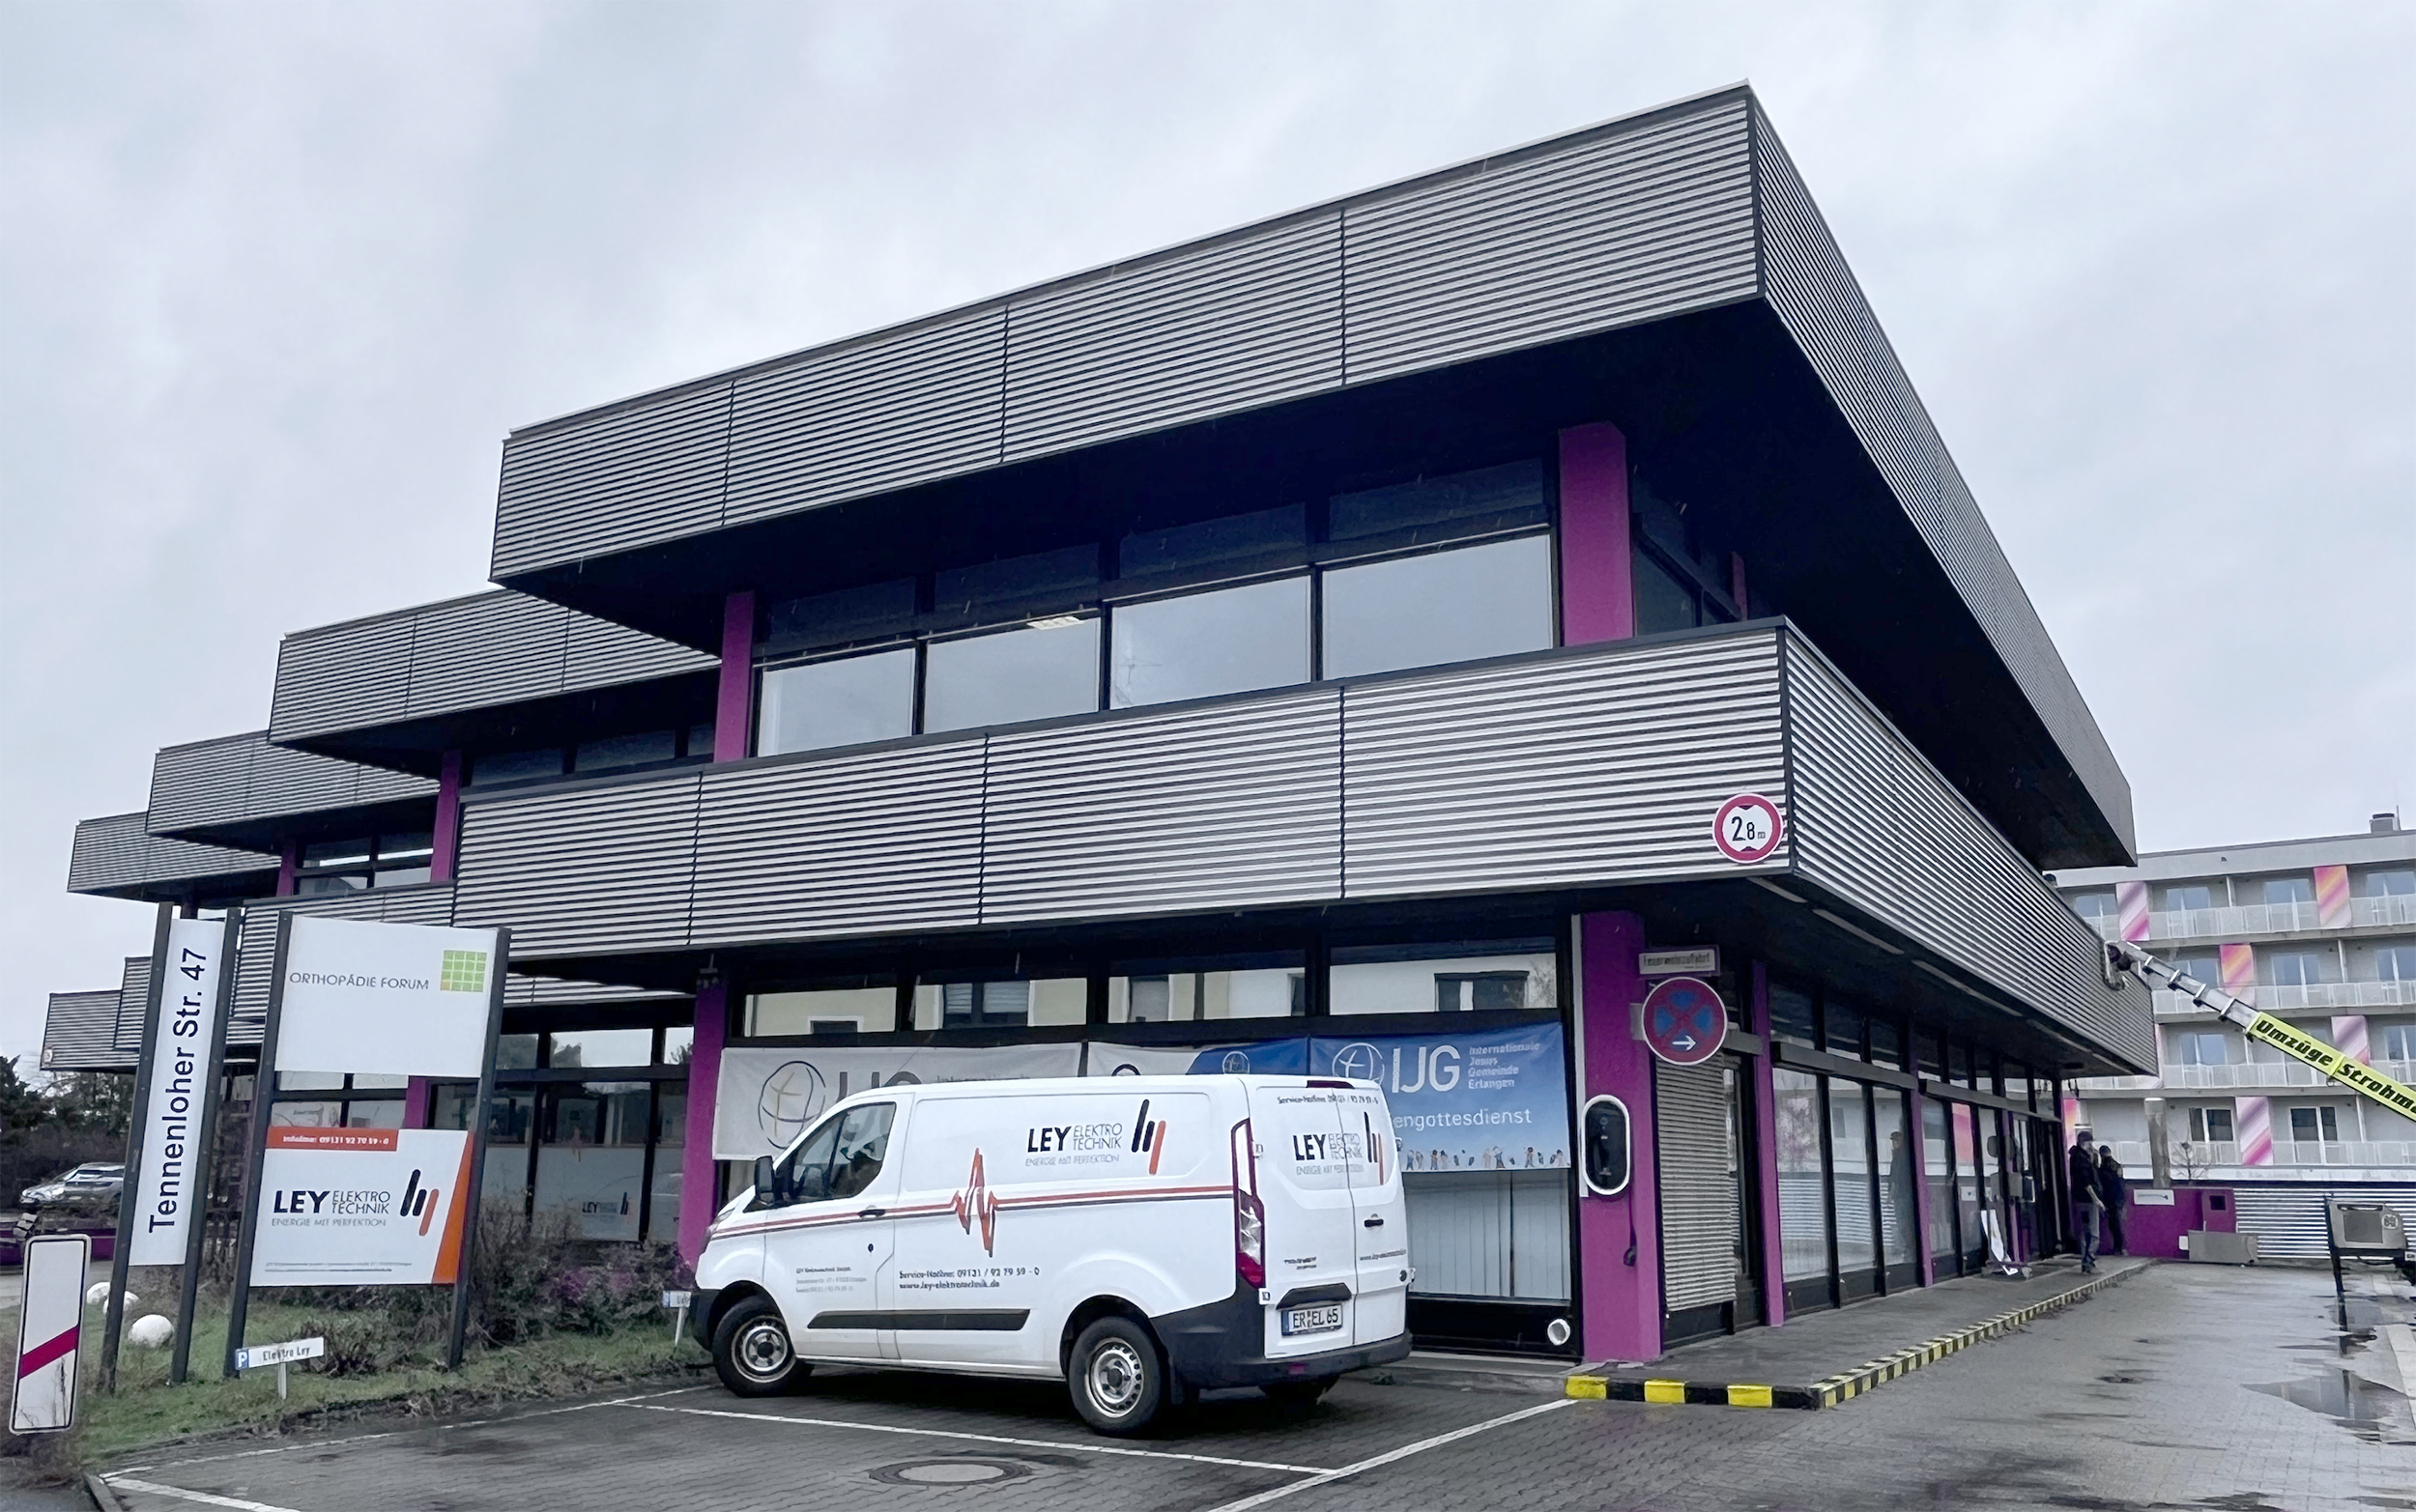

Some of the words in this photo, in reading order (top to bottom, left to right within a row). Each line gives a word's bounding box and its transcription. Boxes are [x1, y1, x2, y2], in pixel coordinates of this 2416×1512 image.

[180, 947, 207, 981] 47
[381, 977, 428, 989] FORUM
[172, 990, 203, 1038] Str.
[2256, 1019, 2333, 1067] Umzüge
[1392, 1044, 1461, 1094] IJG
[1468, 1078, 1515, 1090] Erlangen
[1393, 1108, 1532, 1131] engottesdienst
[148, 1046, 195, 1234] Tennenloher
[1027, 1126, 1072, 1153] LEY
[1073, 1123, 1123, 1138] ELEKTRO
[1073, 1136, 1122, 1151] TECHNIK
[1293, 1134, 1326, 1160] LEY
[273, 1189, 331, 1213] LEY
[332, 1189, 390, 1203] ELEKTRO
[332, 1202, 389, 1214] TECHNIK
[1293, 1312, 1306, 1328] ER
[1327, 1308, 1338, 1325] 65
